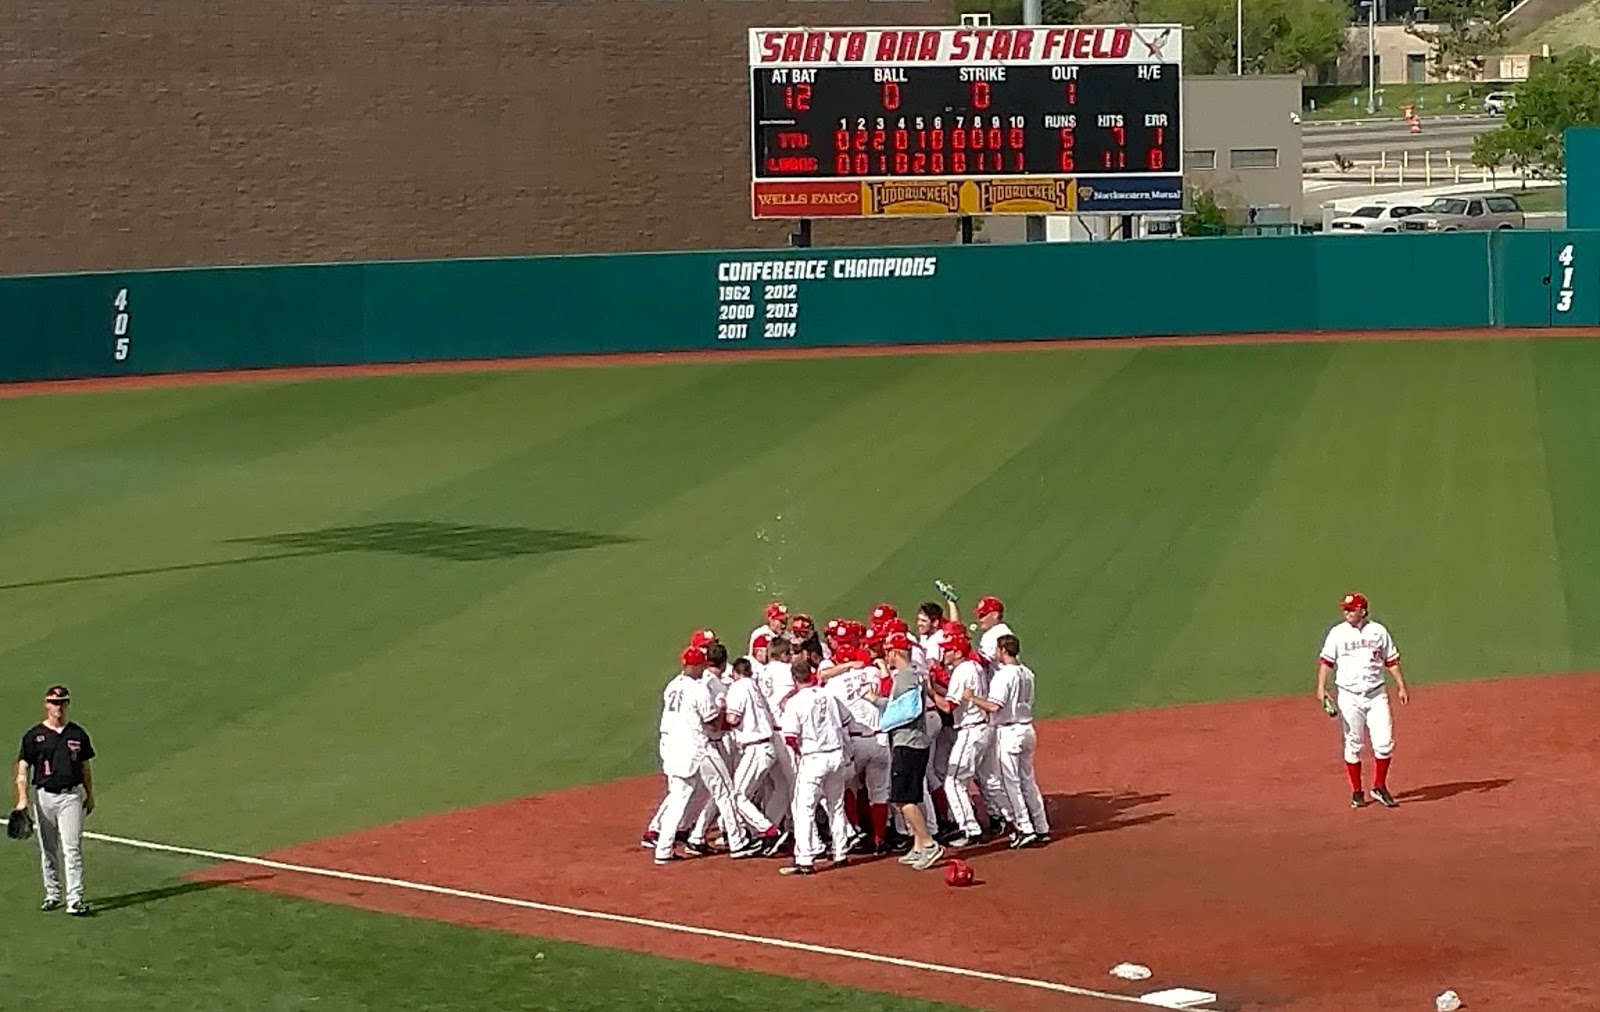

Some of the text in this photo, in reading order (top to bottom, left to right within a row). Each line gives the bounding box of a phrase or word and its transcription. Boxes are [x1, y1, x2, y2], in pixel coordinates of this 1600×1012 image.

[760, 28, 1133, 62] SANTA ANA STAR FIELD
[772, 69, 817, 83] AT BAT
[874, 68, 908, 82] BALL
[959, 67, 1006, 81] STRIKE
[1051, 66, 1079, 81] OUT
[1137, 65, 1161, 79] H/E
[785, 83, 811, 110] 12
[883, 83, 900, 109] 0
[974, 82, 990, 108] 0
[858, 118, 866, 130] 2
[876, 118, 885, 130] 3
[898, 117, 906, 129] 4
[916, 117, 924, 129] 5
[934, 117, 942, 129] 6
[956, 117, 965, 128] 7
[974, 116, 982, 128] 8
[992, 116, 1000, 128] 9
[1009, 116, 1025, 128] 10
[1045, 115, 1077, 129] RUNS
[1097, 115, 1124, 127] HITS
[1145, 114, 1168, 127] ERR
[838, 131, 849, 150] 0
[856, 131, 868, 150] 2
[874, 131, 886, 150] 2
[896, 130, 908, 149] 0
[932, 130, 943, 149] 0
[954, 130, 965, 148] 0
[972, 129, 983, 148] 0
[990, 129, 1001, 148] 0
[1011, 129, 1024, 148] 0
[1061, 128, 1074, 148] 5
[1113, 128, 1125, 146] 7
[856, 153, 868, 173] 0
[914, 153, 925, 172] 2
[932, 153, 943, 172] 0
[1061, 151, 1074, 170] 6
[758, 192, 859, 205] WELLS FARGO
[873, 182, 958, 213] FUDDRUCKERS
[981, 181, 1066, 210] FUDDRUCKERS
[1093, 189, 1181, 200] Northwestern Mutual
[718, 257, 937, 281] CONFERENCE CHAMPIONS
[1556, 245, 1575, 312] 413
[719, 286, 751, 301] 1962
[764, 284, 798, 300] 2012
[719, 304, 754, 320] 2000
[766, 303, 798, 319] 2013
[114, 288, 130, 360] 405
[718, 323, 748, 339] 2011
[764, 322, 797, 338] 2014
